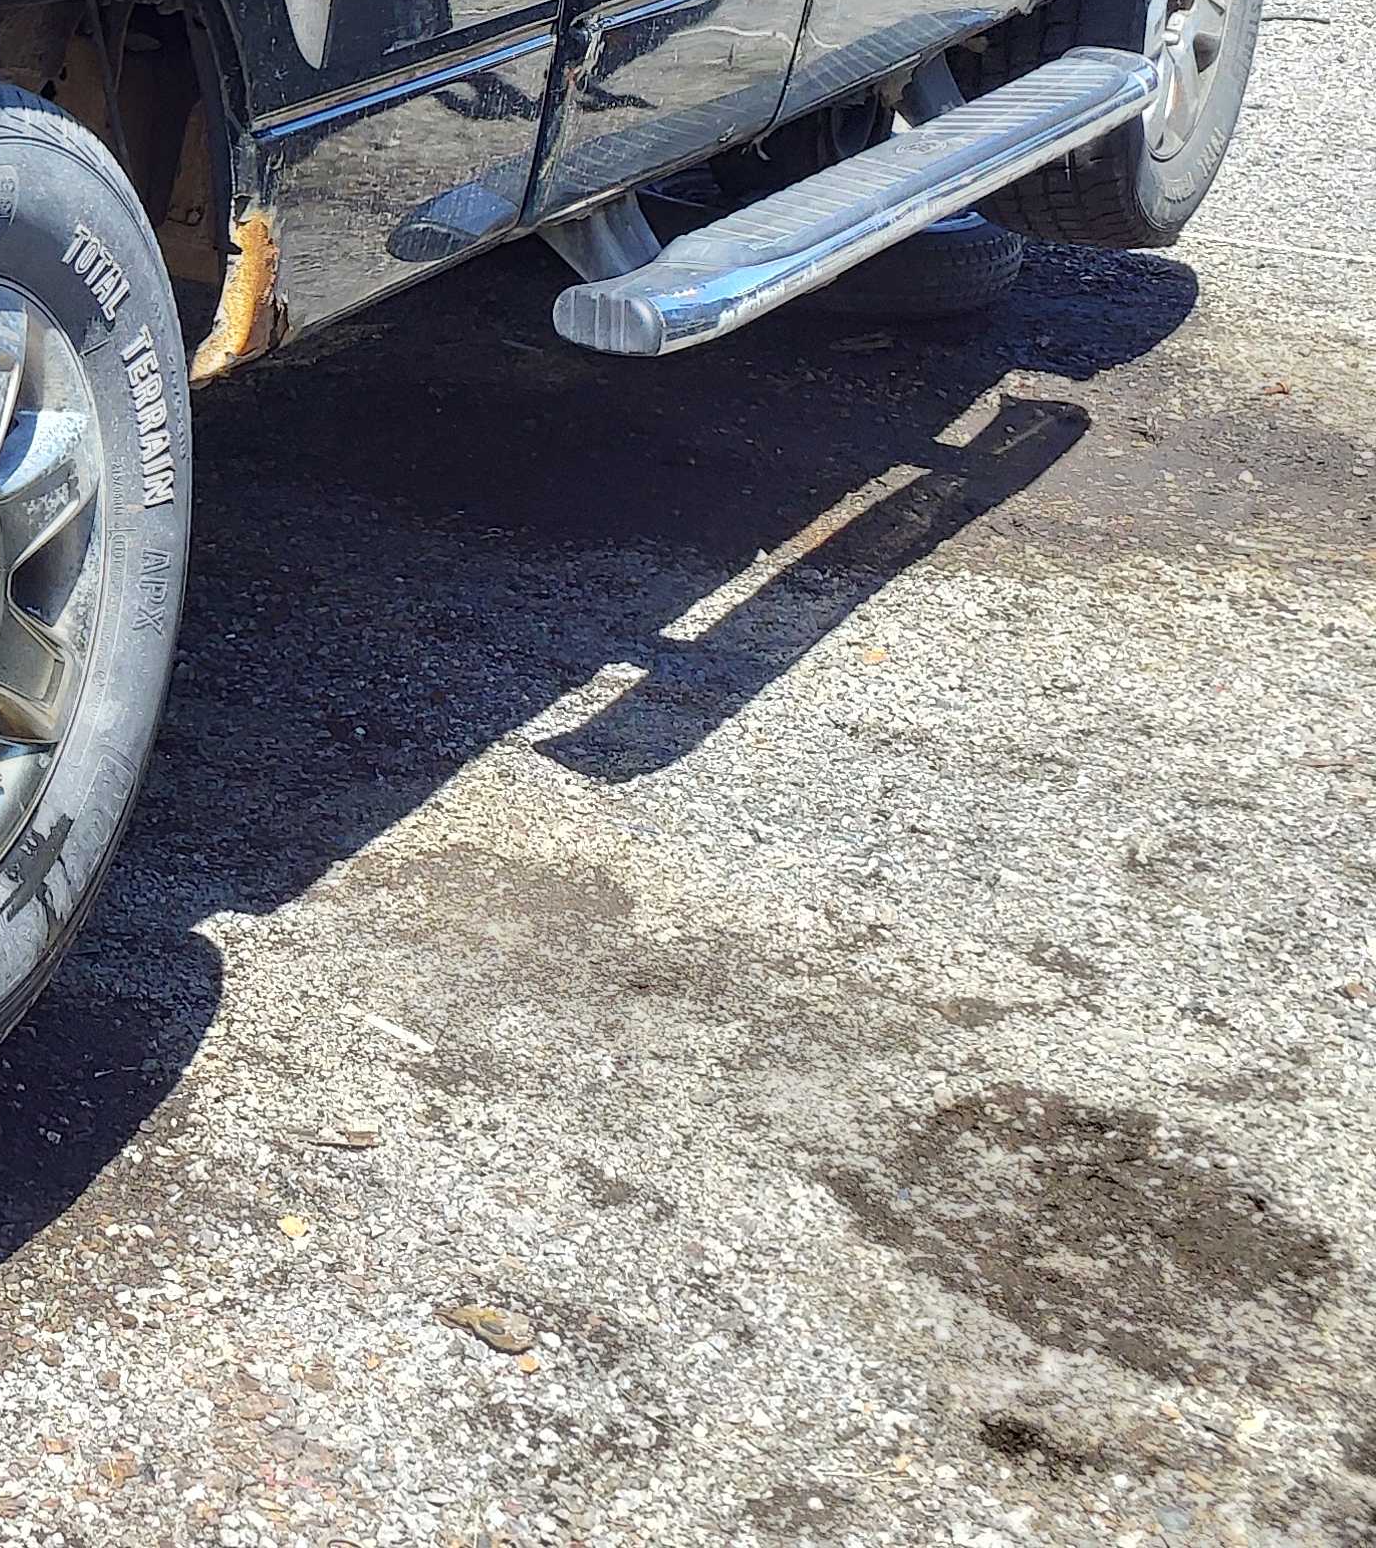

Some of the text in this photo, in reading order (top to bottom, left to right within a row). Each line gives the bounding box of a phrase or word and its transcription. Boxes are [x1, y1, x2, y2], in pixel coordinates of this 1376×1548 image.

[60, 223, 132, 323] TOTAL
[119, 323, 175, 510] TERRAIN
[132, 545, 173, 636] APX
